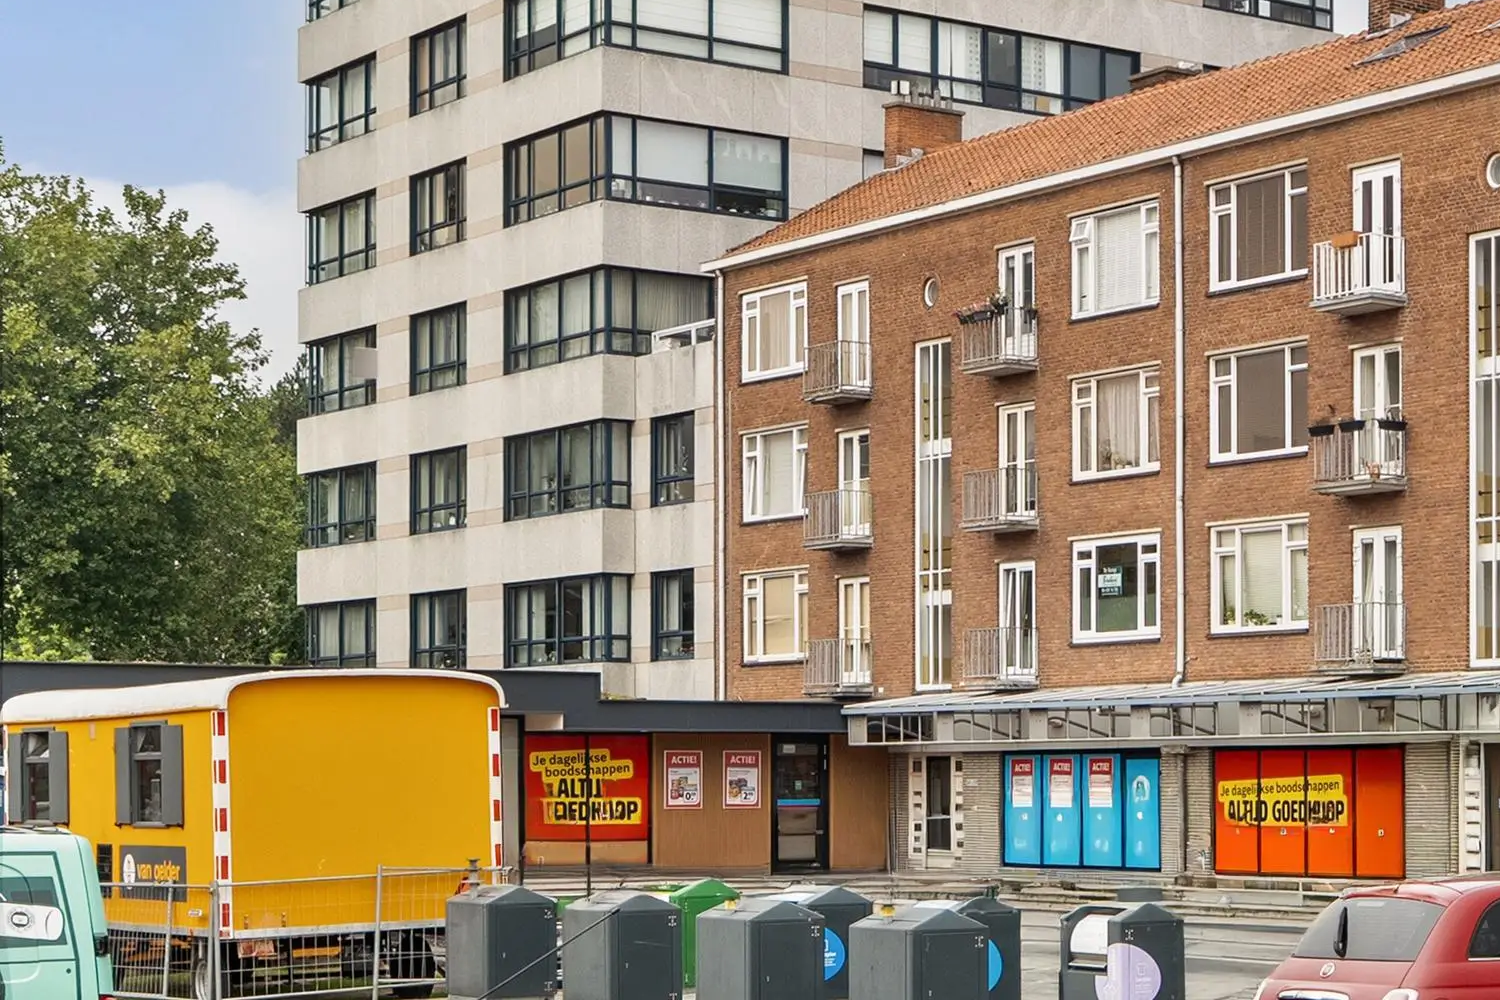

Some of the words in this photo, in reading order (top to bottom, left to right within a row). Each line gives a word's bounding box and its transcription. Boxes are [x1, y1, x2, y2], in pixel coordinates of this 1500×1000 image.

[533, 756, 546, 766] Je
[549, 753, 607, 767] dagelijkse
[671, 755, 697, 764] ACTIE!
[730, 755, 756, 764] ACTIE!
[545, 764, 630, 777] boodschappen
[1221, 786, 1229, 796] Je
[137, 864, 152, 880] van
